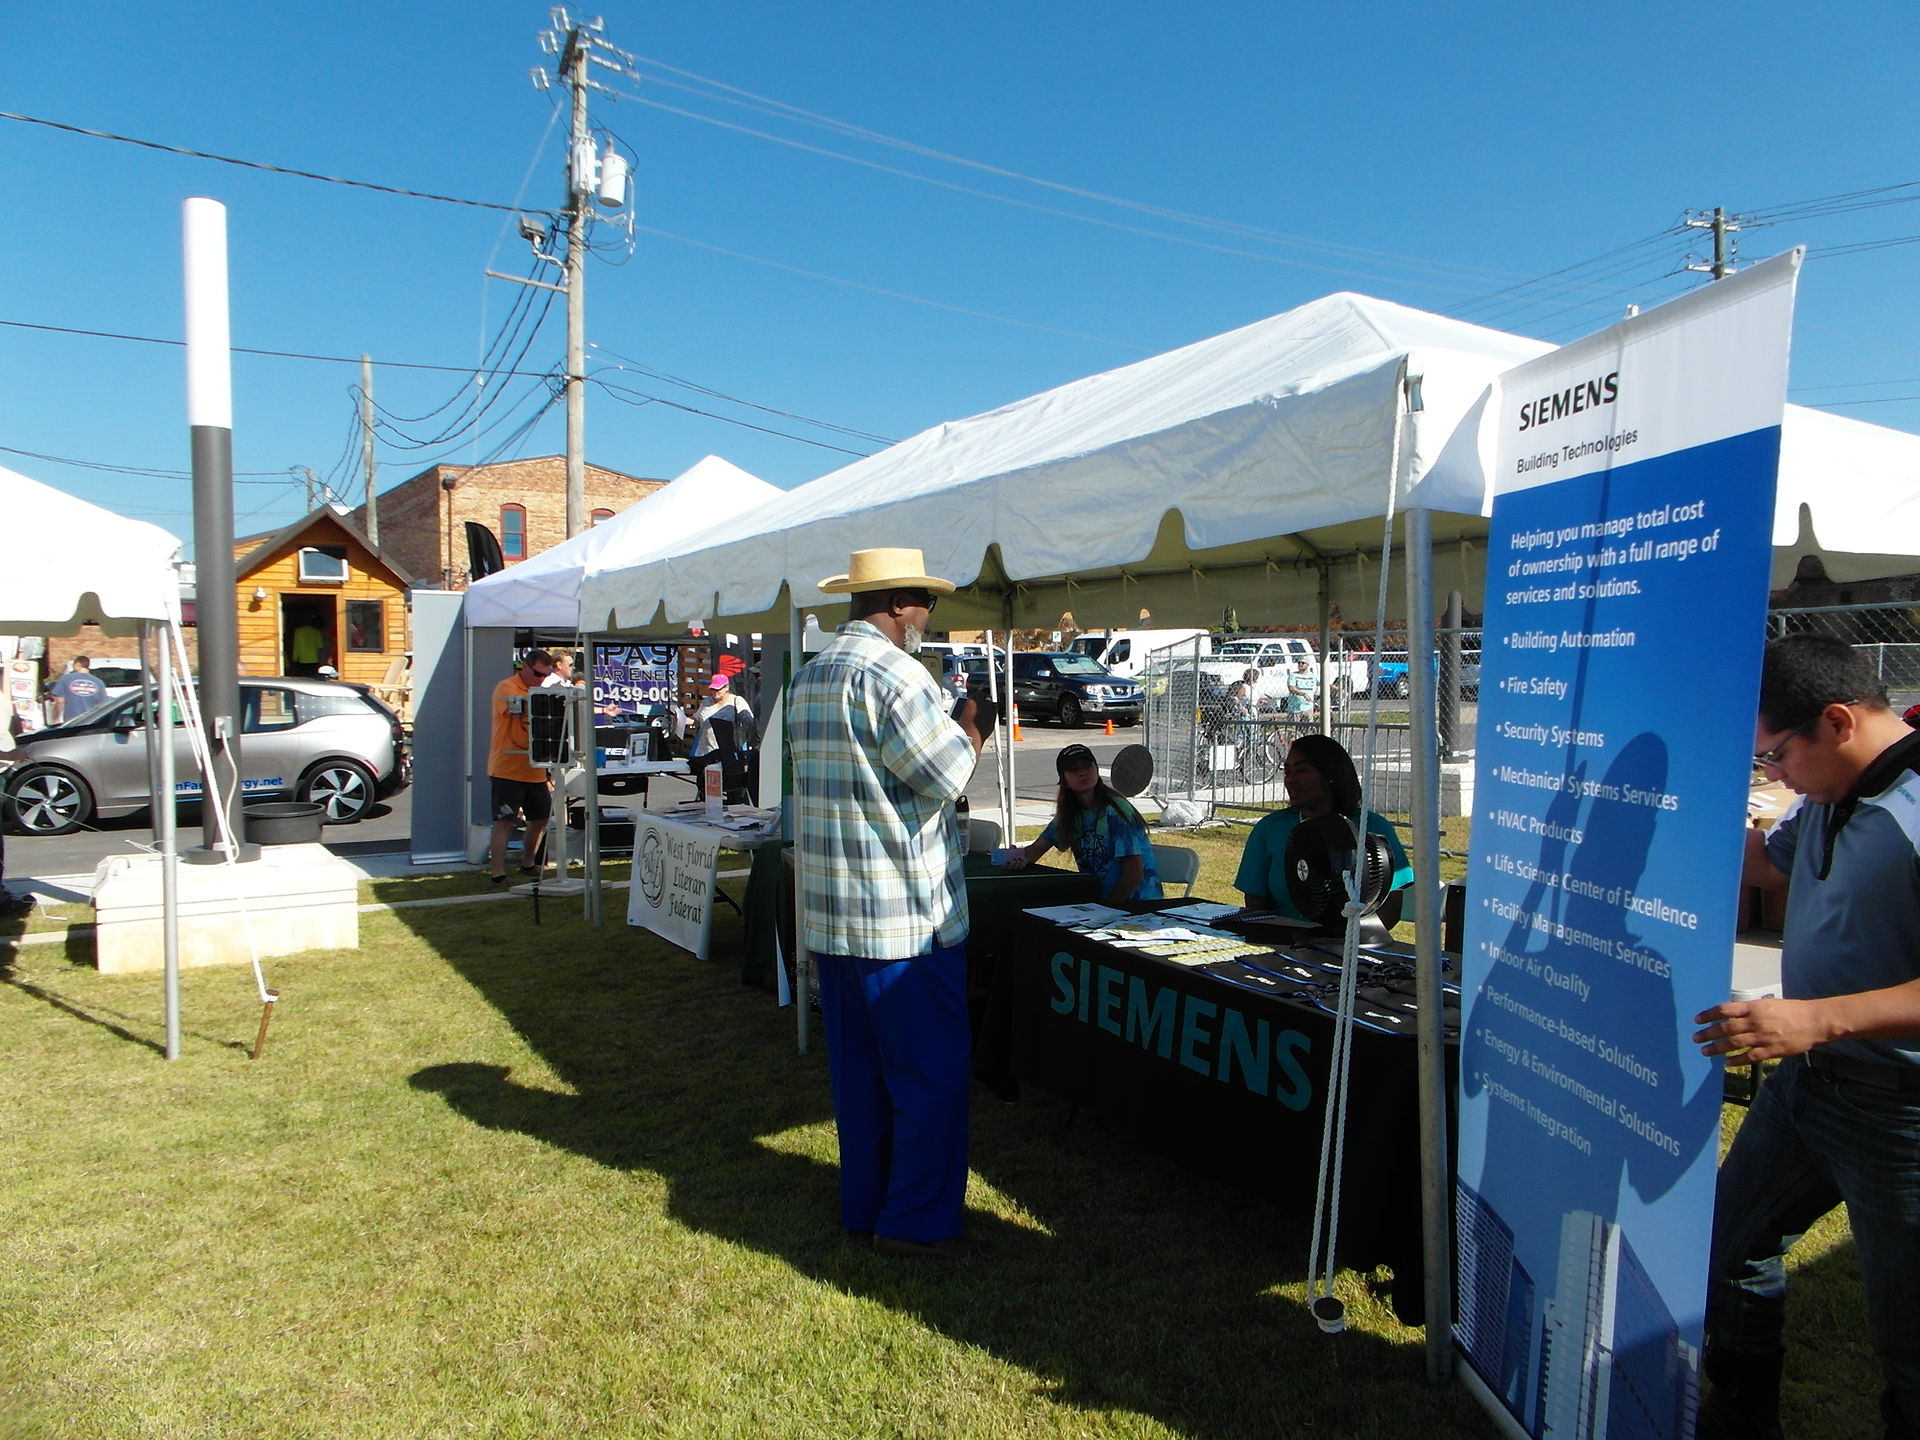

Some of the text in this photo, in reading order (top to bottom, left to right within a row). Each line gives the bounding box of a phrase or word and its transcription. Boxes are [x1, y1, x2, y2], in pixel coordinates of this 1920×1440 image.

[1519, 371, 1619, 431] SIEMENS
[1517, 430, 1638, 473] Building Technologies
[1511, 500, 1704, 550] Helping you manage total cost
[1509, 529, 1720, 577] of ownership with a full range of
[1506, 577, 1641, 605] services and solutions.
[1511, 627, 1635, 653] Building Automation
[1507, 677, 1568, 700] Fire Safety
[1504, 722, 1604, 748] Security Systems
[1500, 766, 1679, 811] Mechanical Systems Services
[666, 832, 683, 861] West
[1497, 809, 1583, 844] HVAC Products
[1494, 854, 1697, 930] Life Science Center of Excellence
[1492, 898, 1671, 979] Facility Management Services
[1490, 942, 1590, 1002] Indoor Air Quality
[1051, 951, 1312, 1112] SIEMENS
[1487, 985, 1658, 1087] Performance-based Solutions
[1482, 1072, 1591, 1156] Systems Integration
[1485, 1029, 1680, 1158] Energy & Environmental Solutions
